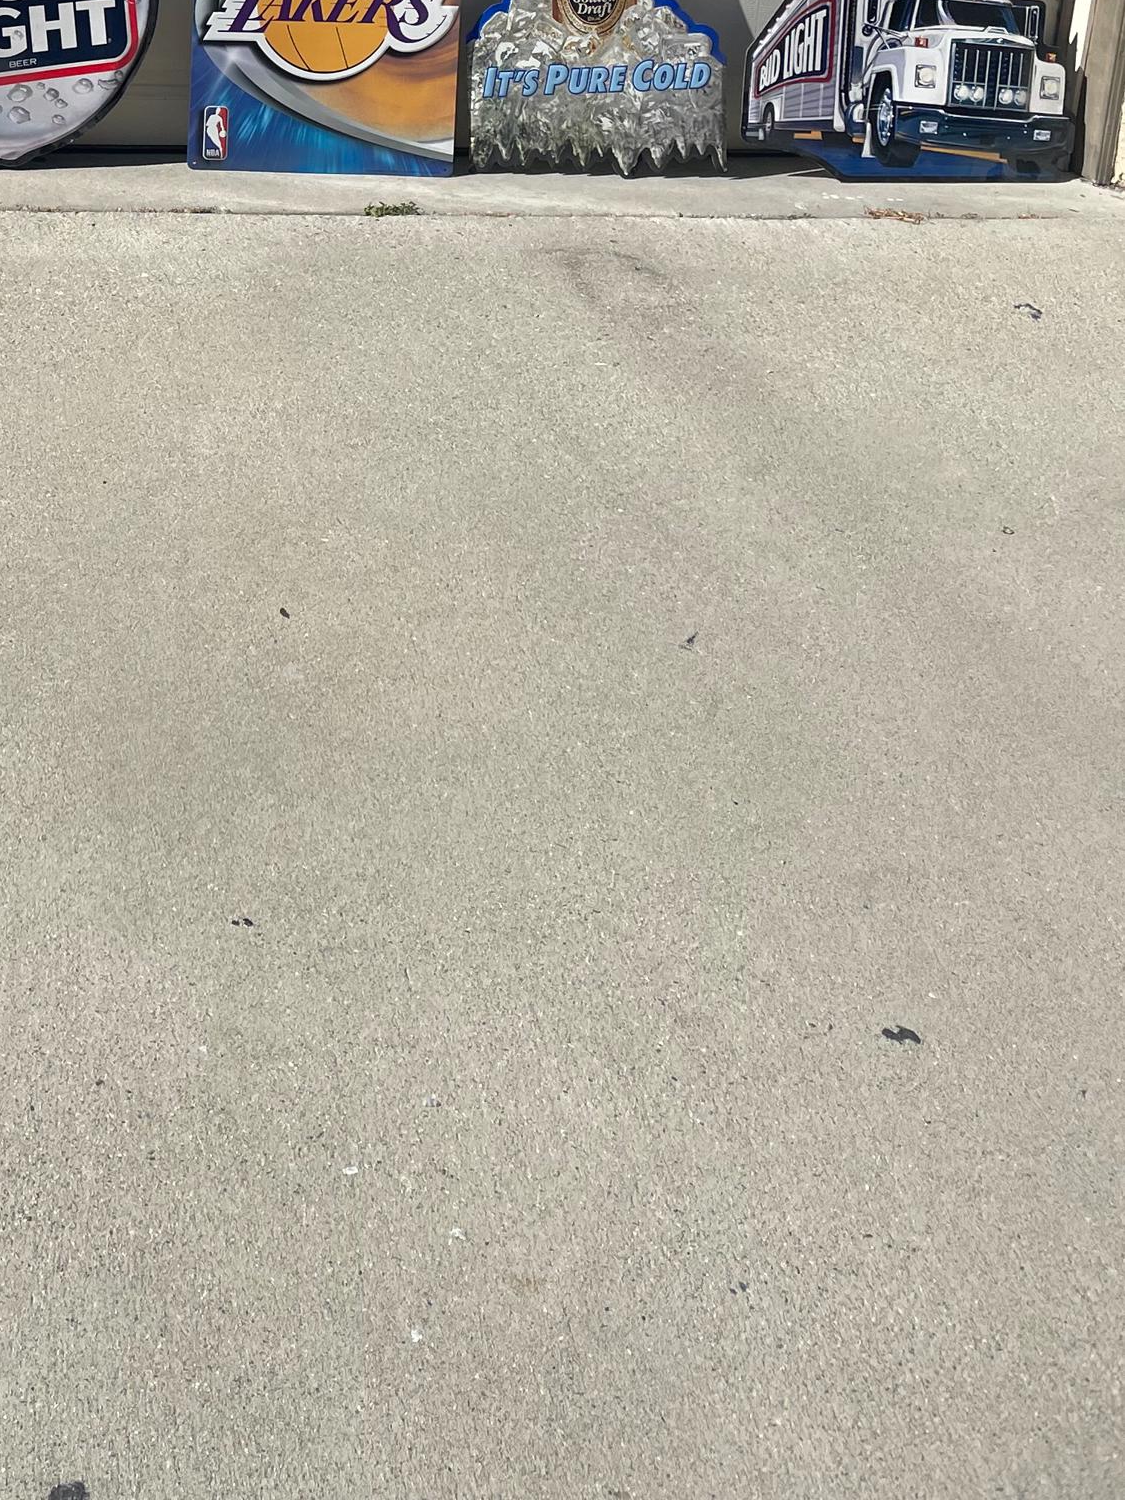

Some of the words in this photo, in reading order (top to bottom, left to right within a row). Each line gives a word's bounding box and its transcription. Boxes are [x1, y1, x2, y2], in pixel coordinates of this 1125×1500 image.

[577, 1, 613, 18] Draft
[758, 49, 781, 92] BUD
[782, 8, 827, 80] LIGHT
[8, 56, 38, 70] BEER
